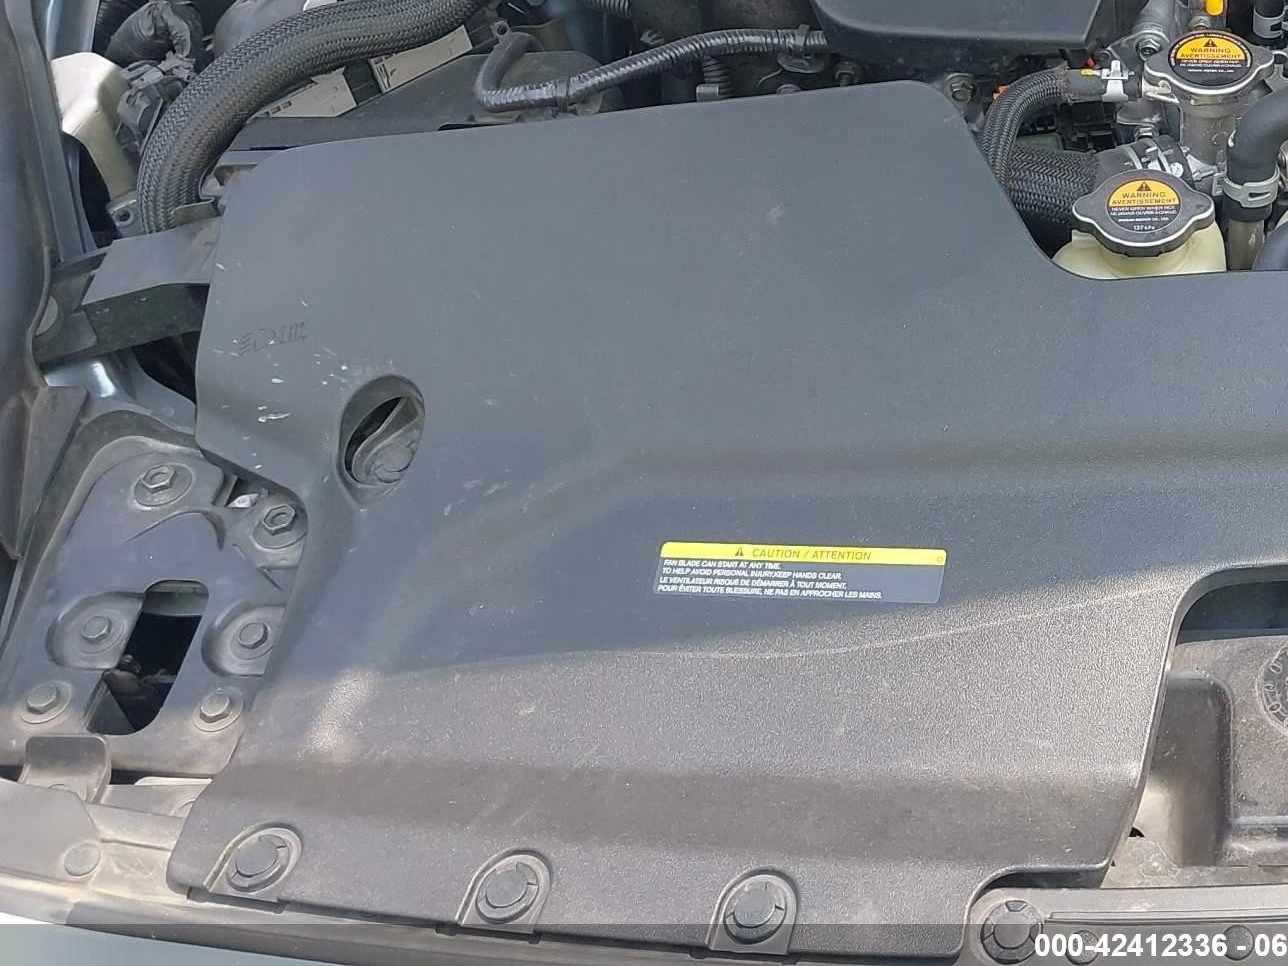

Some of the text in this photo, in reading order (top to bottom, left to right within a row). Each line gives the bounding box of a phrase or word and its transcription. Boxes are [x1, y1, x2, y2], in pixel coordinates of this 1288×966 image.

[1122, 191, 1167, 199] WARNING
[752, 548, 800, 558] CAUTION
[812, 549, 872, 561] ATTENTION
[678, 559, 700, 567] BLADE
[717, 560, 738, 568] START
[662, 567, 672, 575] TO
[672, 567, 690, 575] HELP
[712, 569, 750, 577] PERSONAL
[792, 571, 817, 579] HANDS
[660, 576, 669, 584] LE
[669, 576, 713, 585] VENTILATEUR
[713, 578, 740, 586] RISQUE
[751, 578, 789, 588] DÉMARRER
[797, 581, 815, 589] TOUT
[657, 584, 678, 592] POUR
[678, 584, 702, 593] ÉVITER
[703, 586, 725, 594] TOUTE
[774, 588, 789, 596] PAS
[789, 589, 801, 597] EN
[801, 589, 844, 598] APPROCHER
